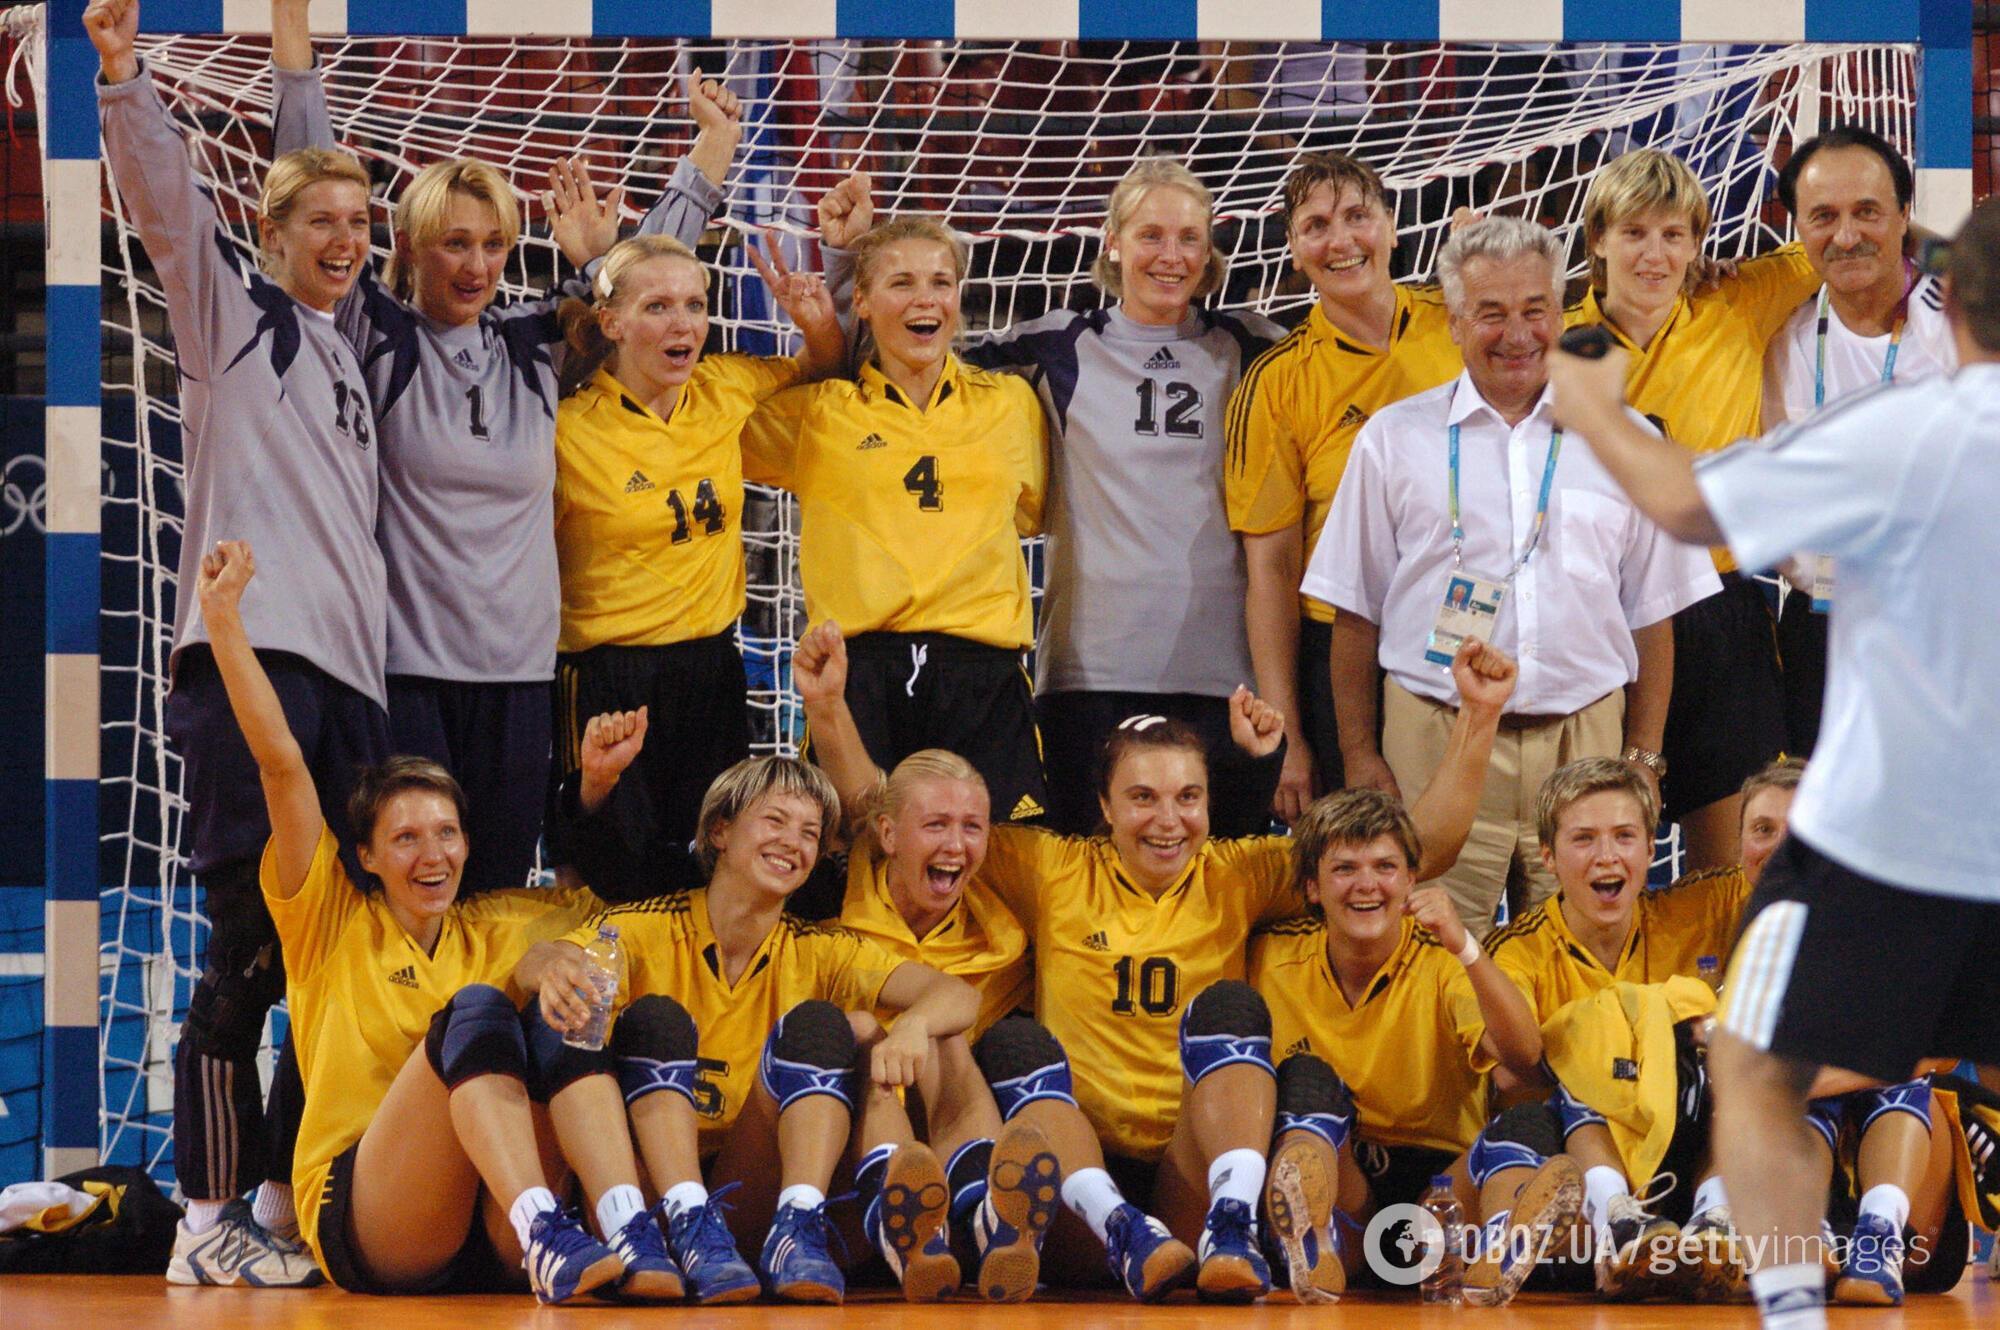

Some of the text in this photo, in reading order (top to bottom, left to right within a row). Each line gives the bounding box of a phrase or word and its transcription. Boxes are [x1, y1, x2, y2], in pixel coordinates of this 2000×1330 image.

[1144, 360, 1180, 369] adidas
[333, 380, 370, 450] 16
[465, 384, 490, 441] 1
[1135, 378, 1203, 439] 12
[666, 478, 725, 545] 14
[903, 455, 944, 512] 4
[1112, 955, 1180, 1017] 10
[694, 1057, 730, 1120] 5
